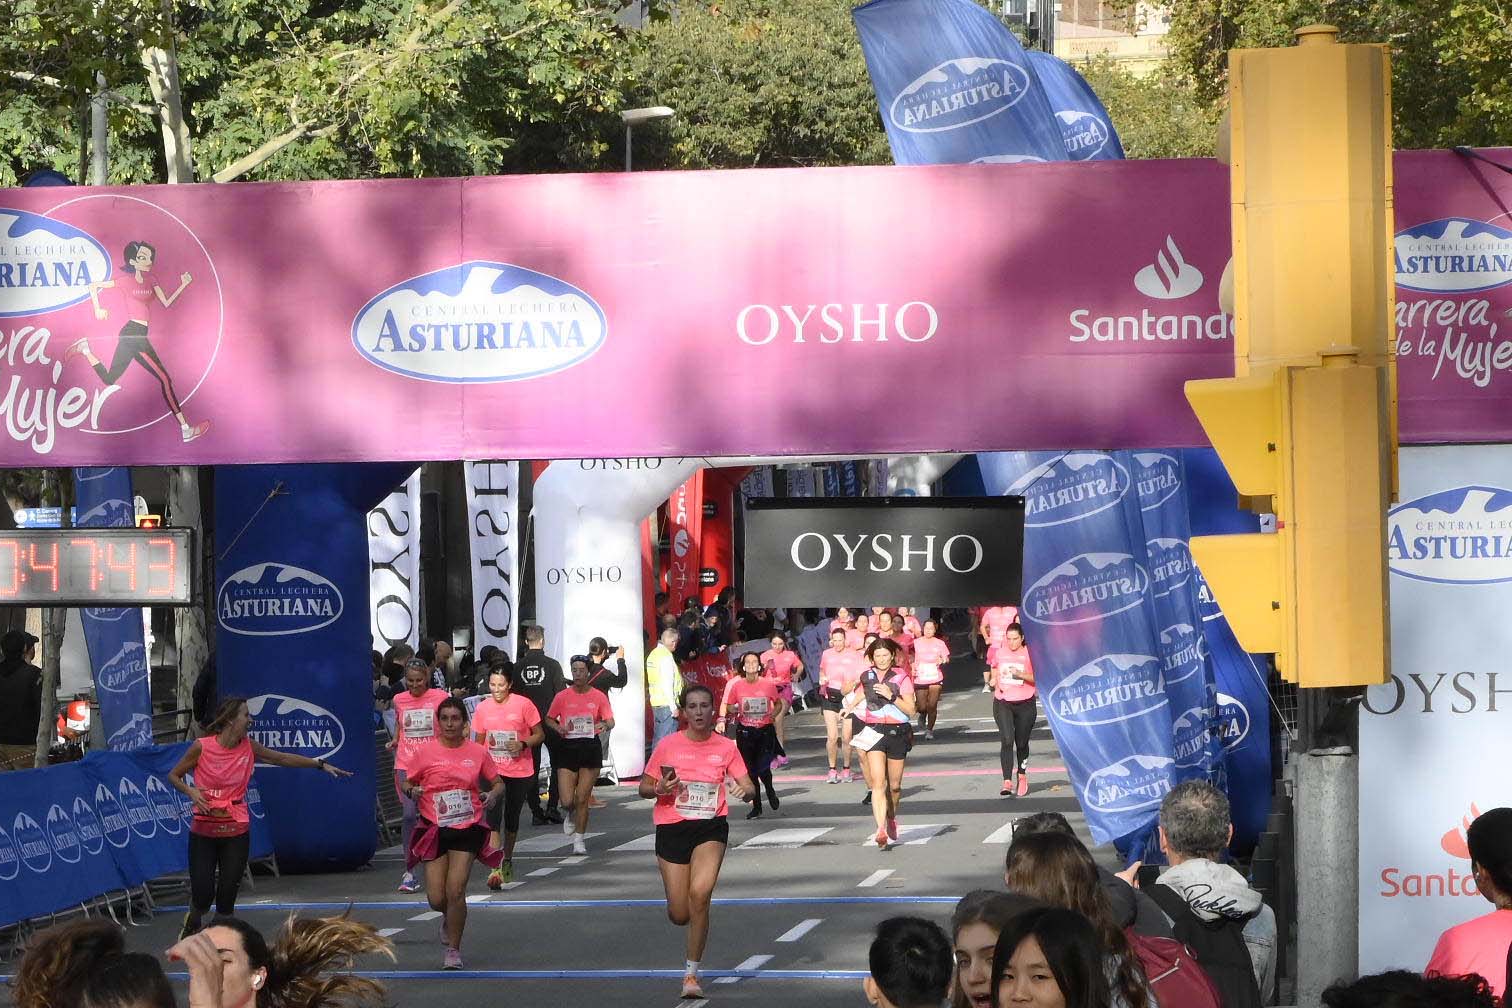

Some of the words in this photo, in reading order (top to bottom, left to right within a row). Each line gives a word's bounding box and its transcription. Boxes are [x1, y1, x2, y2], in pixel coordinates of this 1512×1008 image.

[13, 244, 86, 257] LECHERA
[1408, 242, 1458, 252] CENTRAL
[1464, 242, 1512, 251] LECHER
[410, 303, 491, 318] CENTRAL
[497, 300, 579, 316] LECHERA
[1395, 299, 1490, 327] arrera
[371, 307, 586, 354] ASTURIANA
[736, 300, 939, 346] OYSHO
[1418, 329, 1435, 355] la
[1415, 519, 1484, 531] CENTRAL
[790, 532, 984, 573] OYSHO
[546, 565, 623, 585] OYSHO
[234, 587, 279, 596] CENTRAL
[281, 587, 330, 596] LECHERA
[221, 590, 334, 618] ASTURIANA
[526, 670, 540, 680] BP
[1381, 867, 1481, 897] Santa
